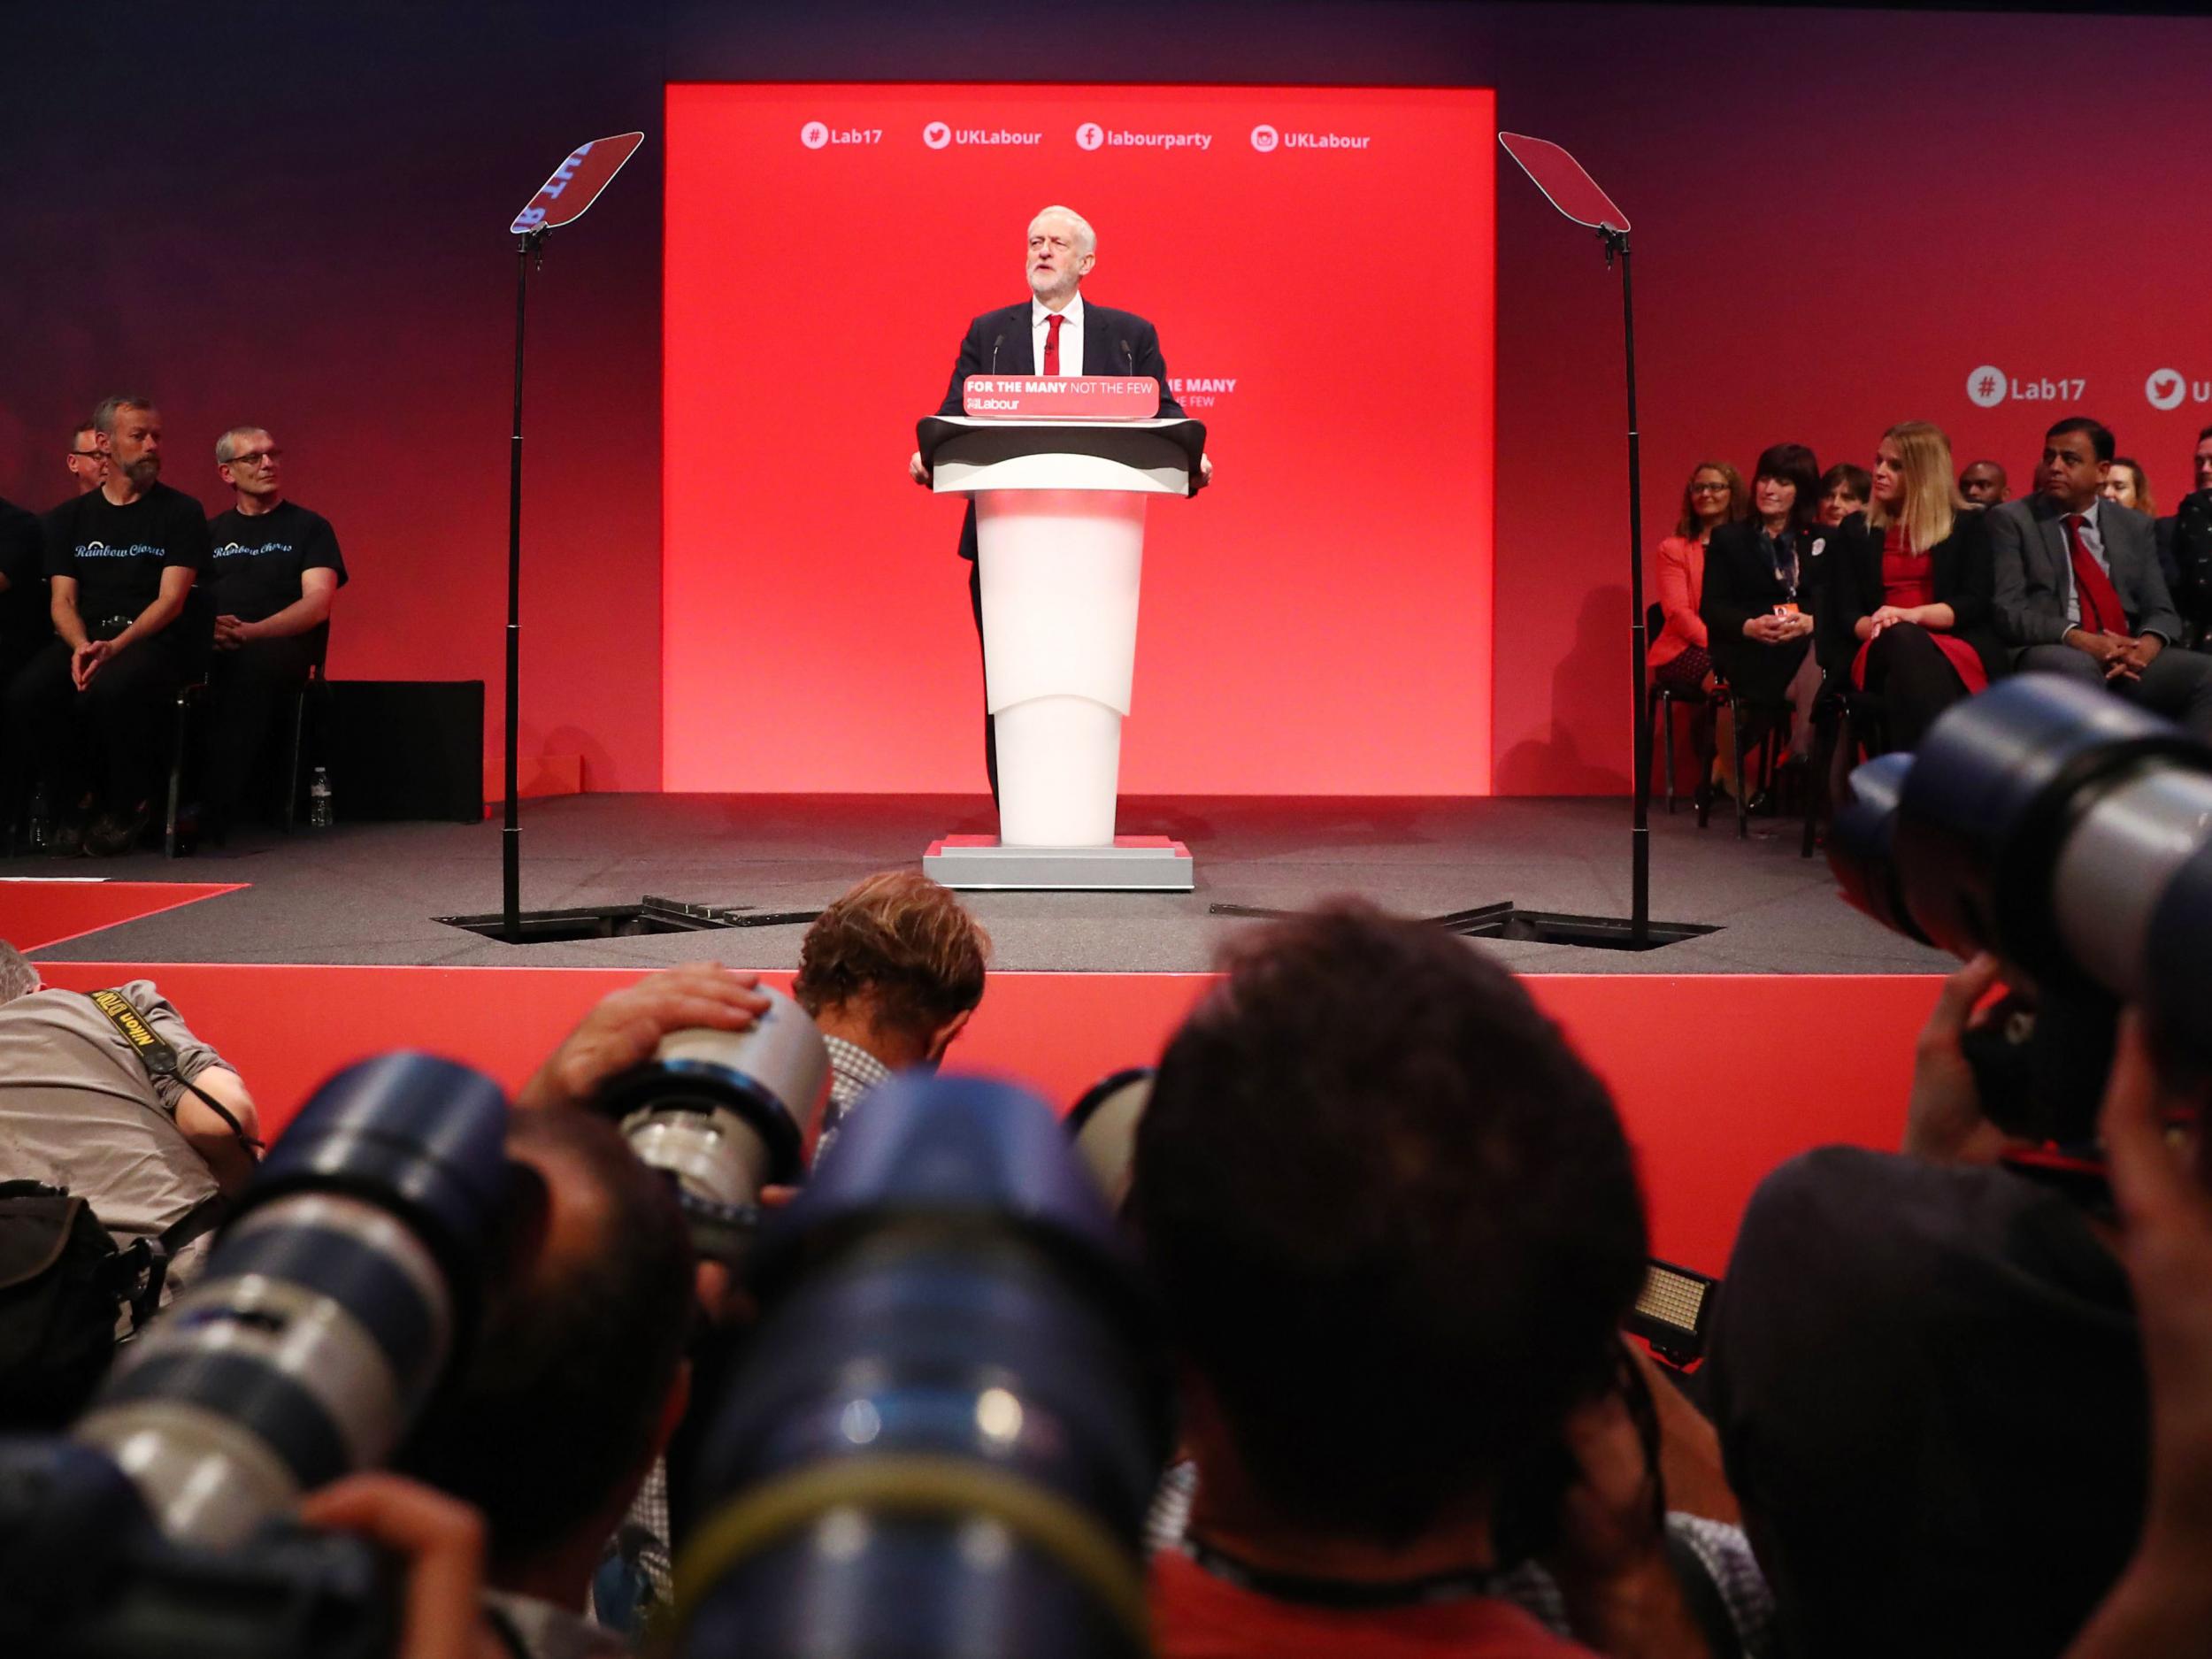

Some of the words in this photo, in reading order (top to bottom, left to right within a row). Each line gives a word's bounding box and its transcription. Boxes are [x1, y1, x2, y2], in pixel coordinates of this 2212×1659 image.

[832, 128, 883, 144] Lab17
[956, 129, 1042, 145] UKLabour
[1107, 130, 1212, 150] labourparty
[1284, 133, 1371, 149] UKLabour
[967, 381, 994, 393] FOR
[996, 381, 1022, 393] THE
[1025, 381, 1067, 394] MANY
[1070, 382, 1098, 394] NOT
[1100, 382, 1125, 394] THE
[1126, 382, 1153, 395] FEW
[1186, 378, 1237, 393] MANY
[2011, 378, 2086, 401] Lab17
[2193, 380, 2212, 403] U
[977, 398, 1020, 410] Labour
[1189, 395, 1216, 408] FEW
[74, 544, 128, 557] Rainbow
[128, 543, 165, 557] Chorus
[212, 545, 259, 558] Rainbow
[119, 1011, 155, 1046] Nikon
